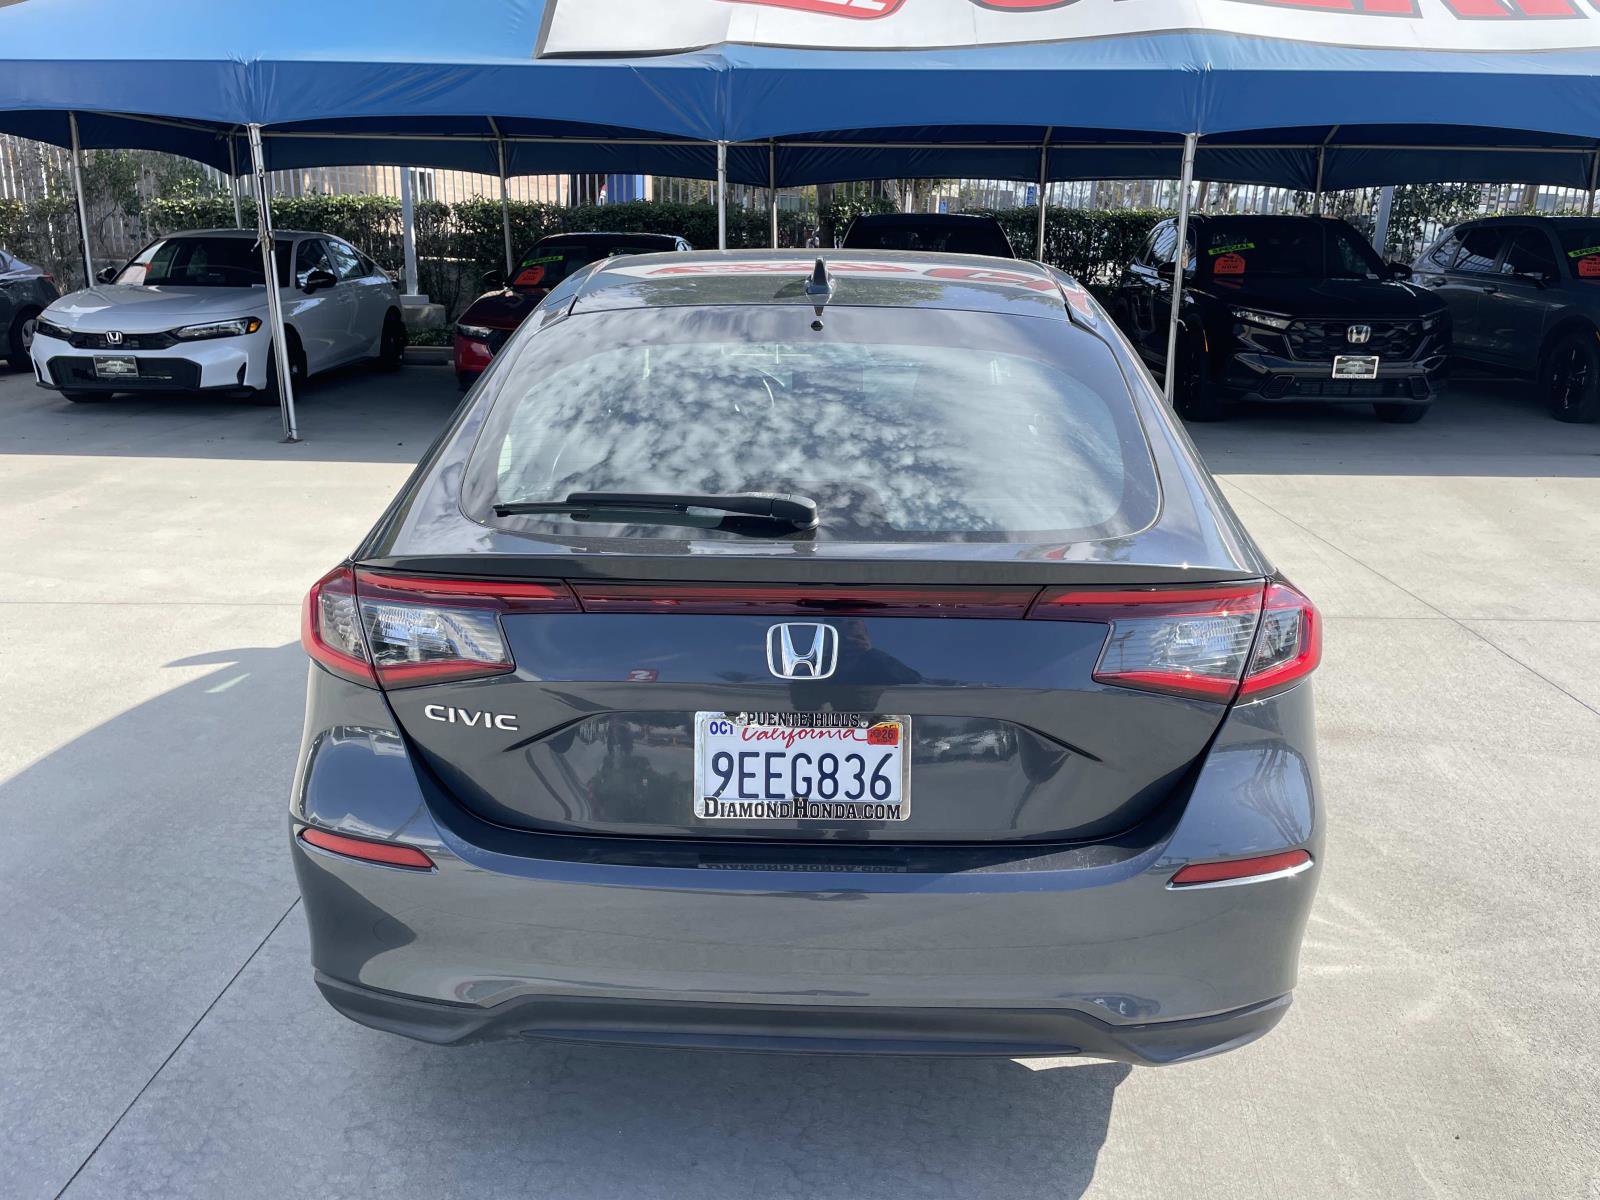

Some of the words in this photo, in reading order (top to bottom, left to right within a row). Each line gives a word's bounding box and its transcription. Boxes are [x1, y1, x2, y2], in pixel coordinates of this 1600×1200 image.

[424, 704, 518, 731] CIVIC
[709, 721, 734, 735] OCT
[747, 712, 811, 727] PUENTE
[813, 712, 860, 728] HILLS
[742, 727, 867, 749] California
[711, 751, 893, 801] 9EEG836
